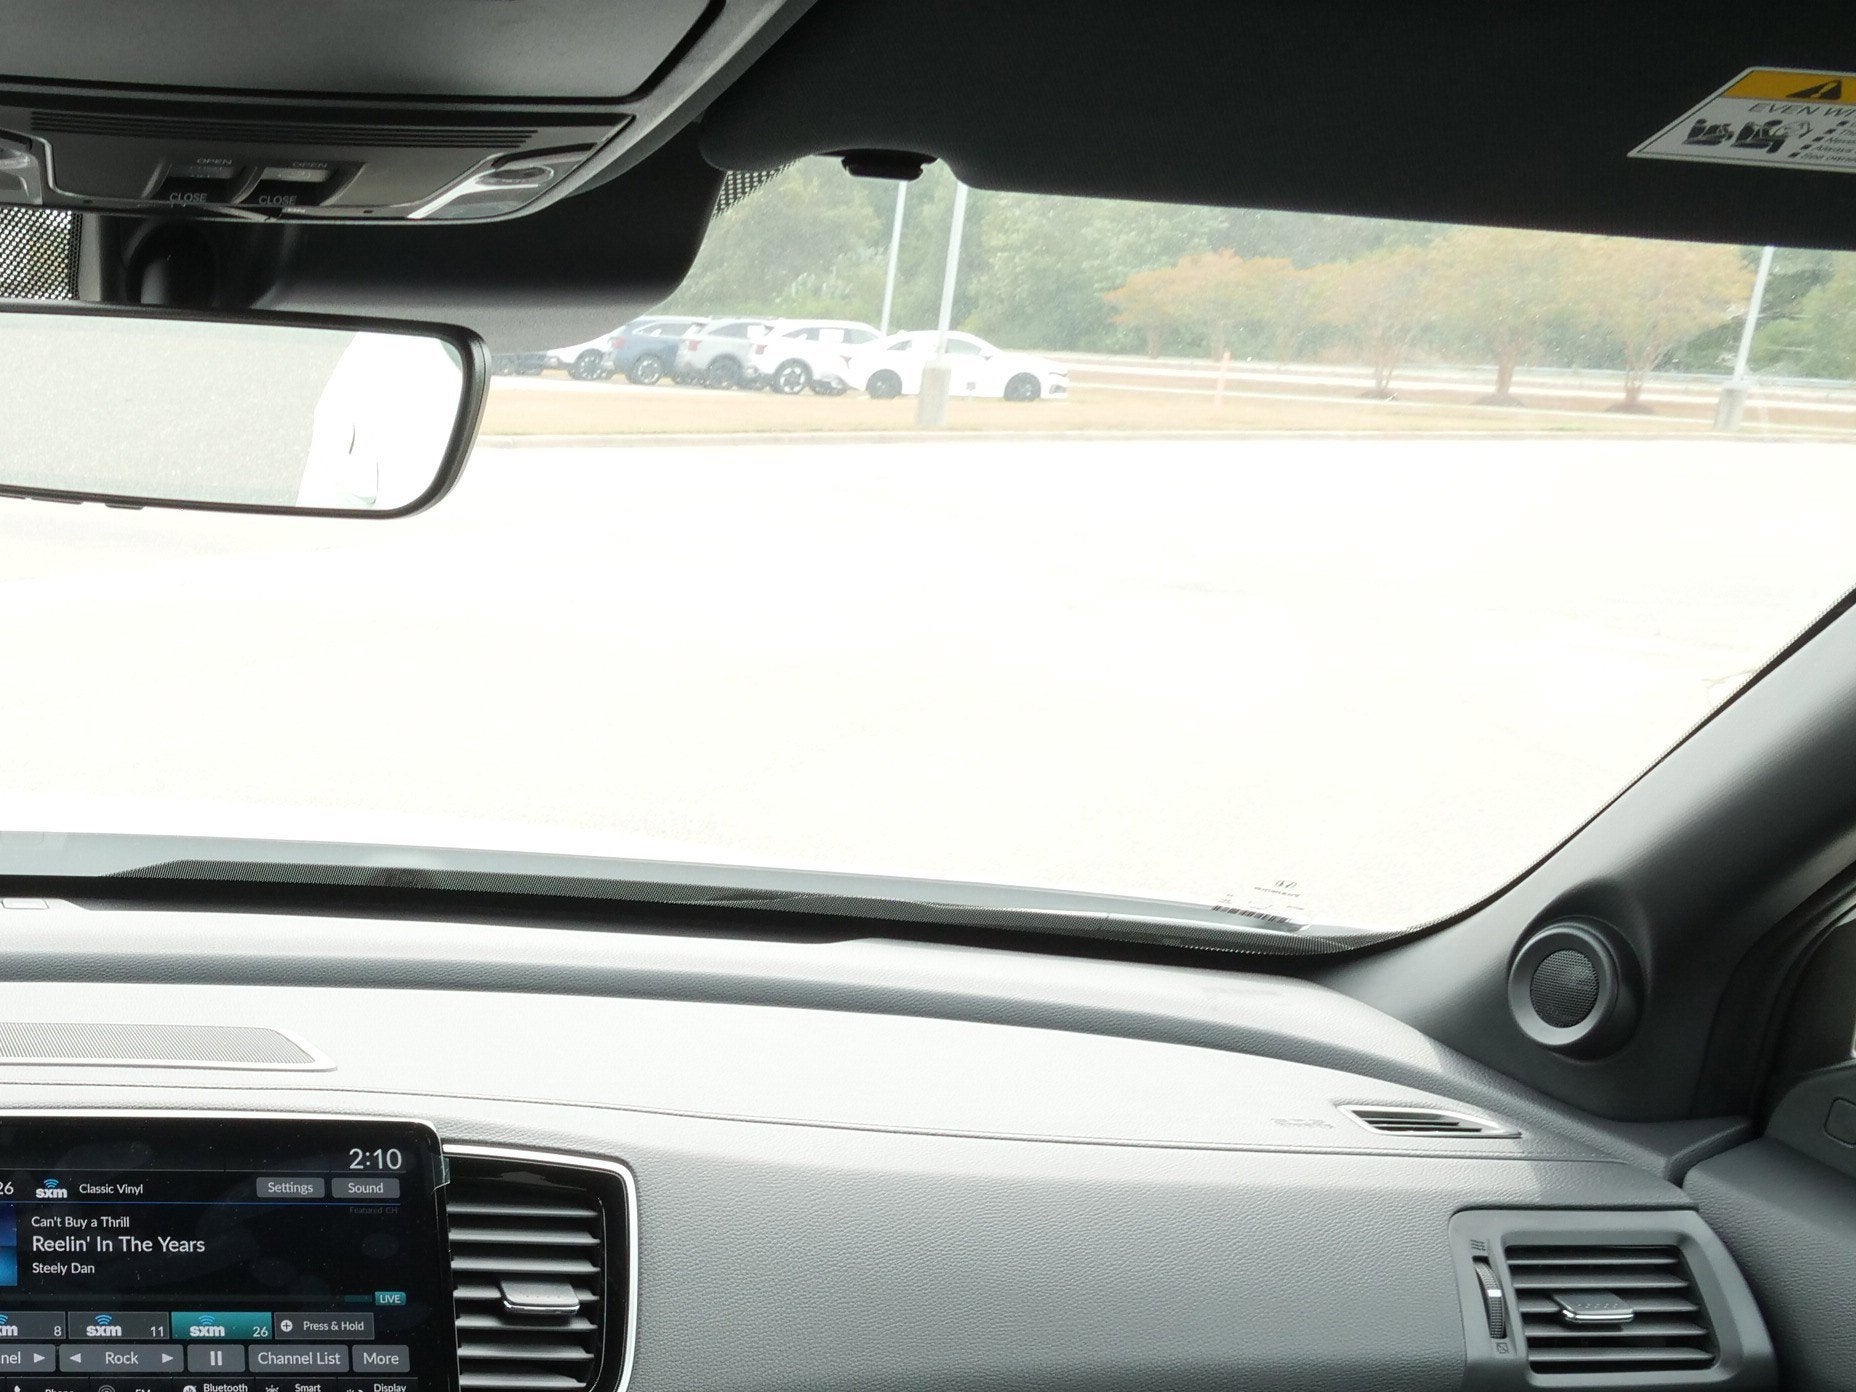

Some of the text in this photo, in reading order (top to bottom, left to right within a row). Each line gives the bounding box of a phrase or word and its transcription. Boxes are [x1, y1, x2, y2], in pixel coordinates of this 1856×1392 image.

[169, 192, 208, 202] CLOSE
[258, 195, 297, 205] CLOSE
[348, 1148, 402, 1170] 2:10
[36, 1188, 68, 1199] sxm
[79, 1184, 143, 1196] Classic Vinyl
[268, 1182, 314, 1195] Settings
[348, 1182, 384, 1194] Sound
[349, 1206, 382, 1214] Featured
[32, 1216, 130, 1230] Can't Buy a Thrill
[32, 1236, 206, 1252] Reelin' In The Years
[32, 1263, 95, 1276] Steely Dan
[379, 1295, 401, 1304] LIVE
[53, 1326, 62, 1337] 8
[86, 1325, 122, 1337] sxm
[150, 1326, 164, 1337] 11
[189, 1326, 226, 1338] sxm
[252, 1326, 268, 1338] 26
[303, 1320, 364, 1332] Press & Hold
[105, 1352, 139, 1365] Rock
[258, 1352, 341, 1365] Channel List
[363, 1352, 400, 1364] More
[294, 1384, 322, 1392] Smart
